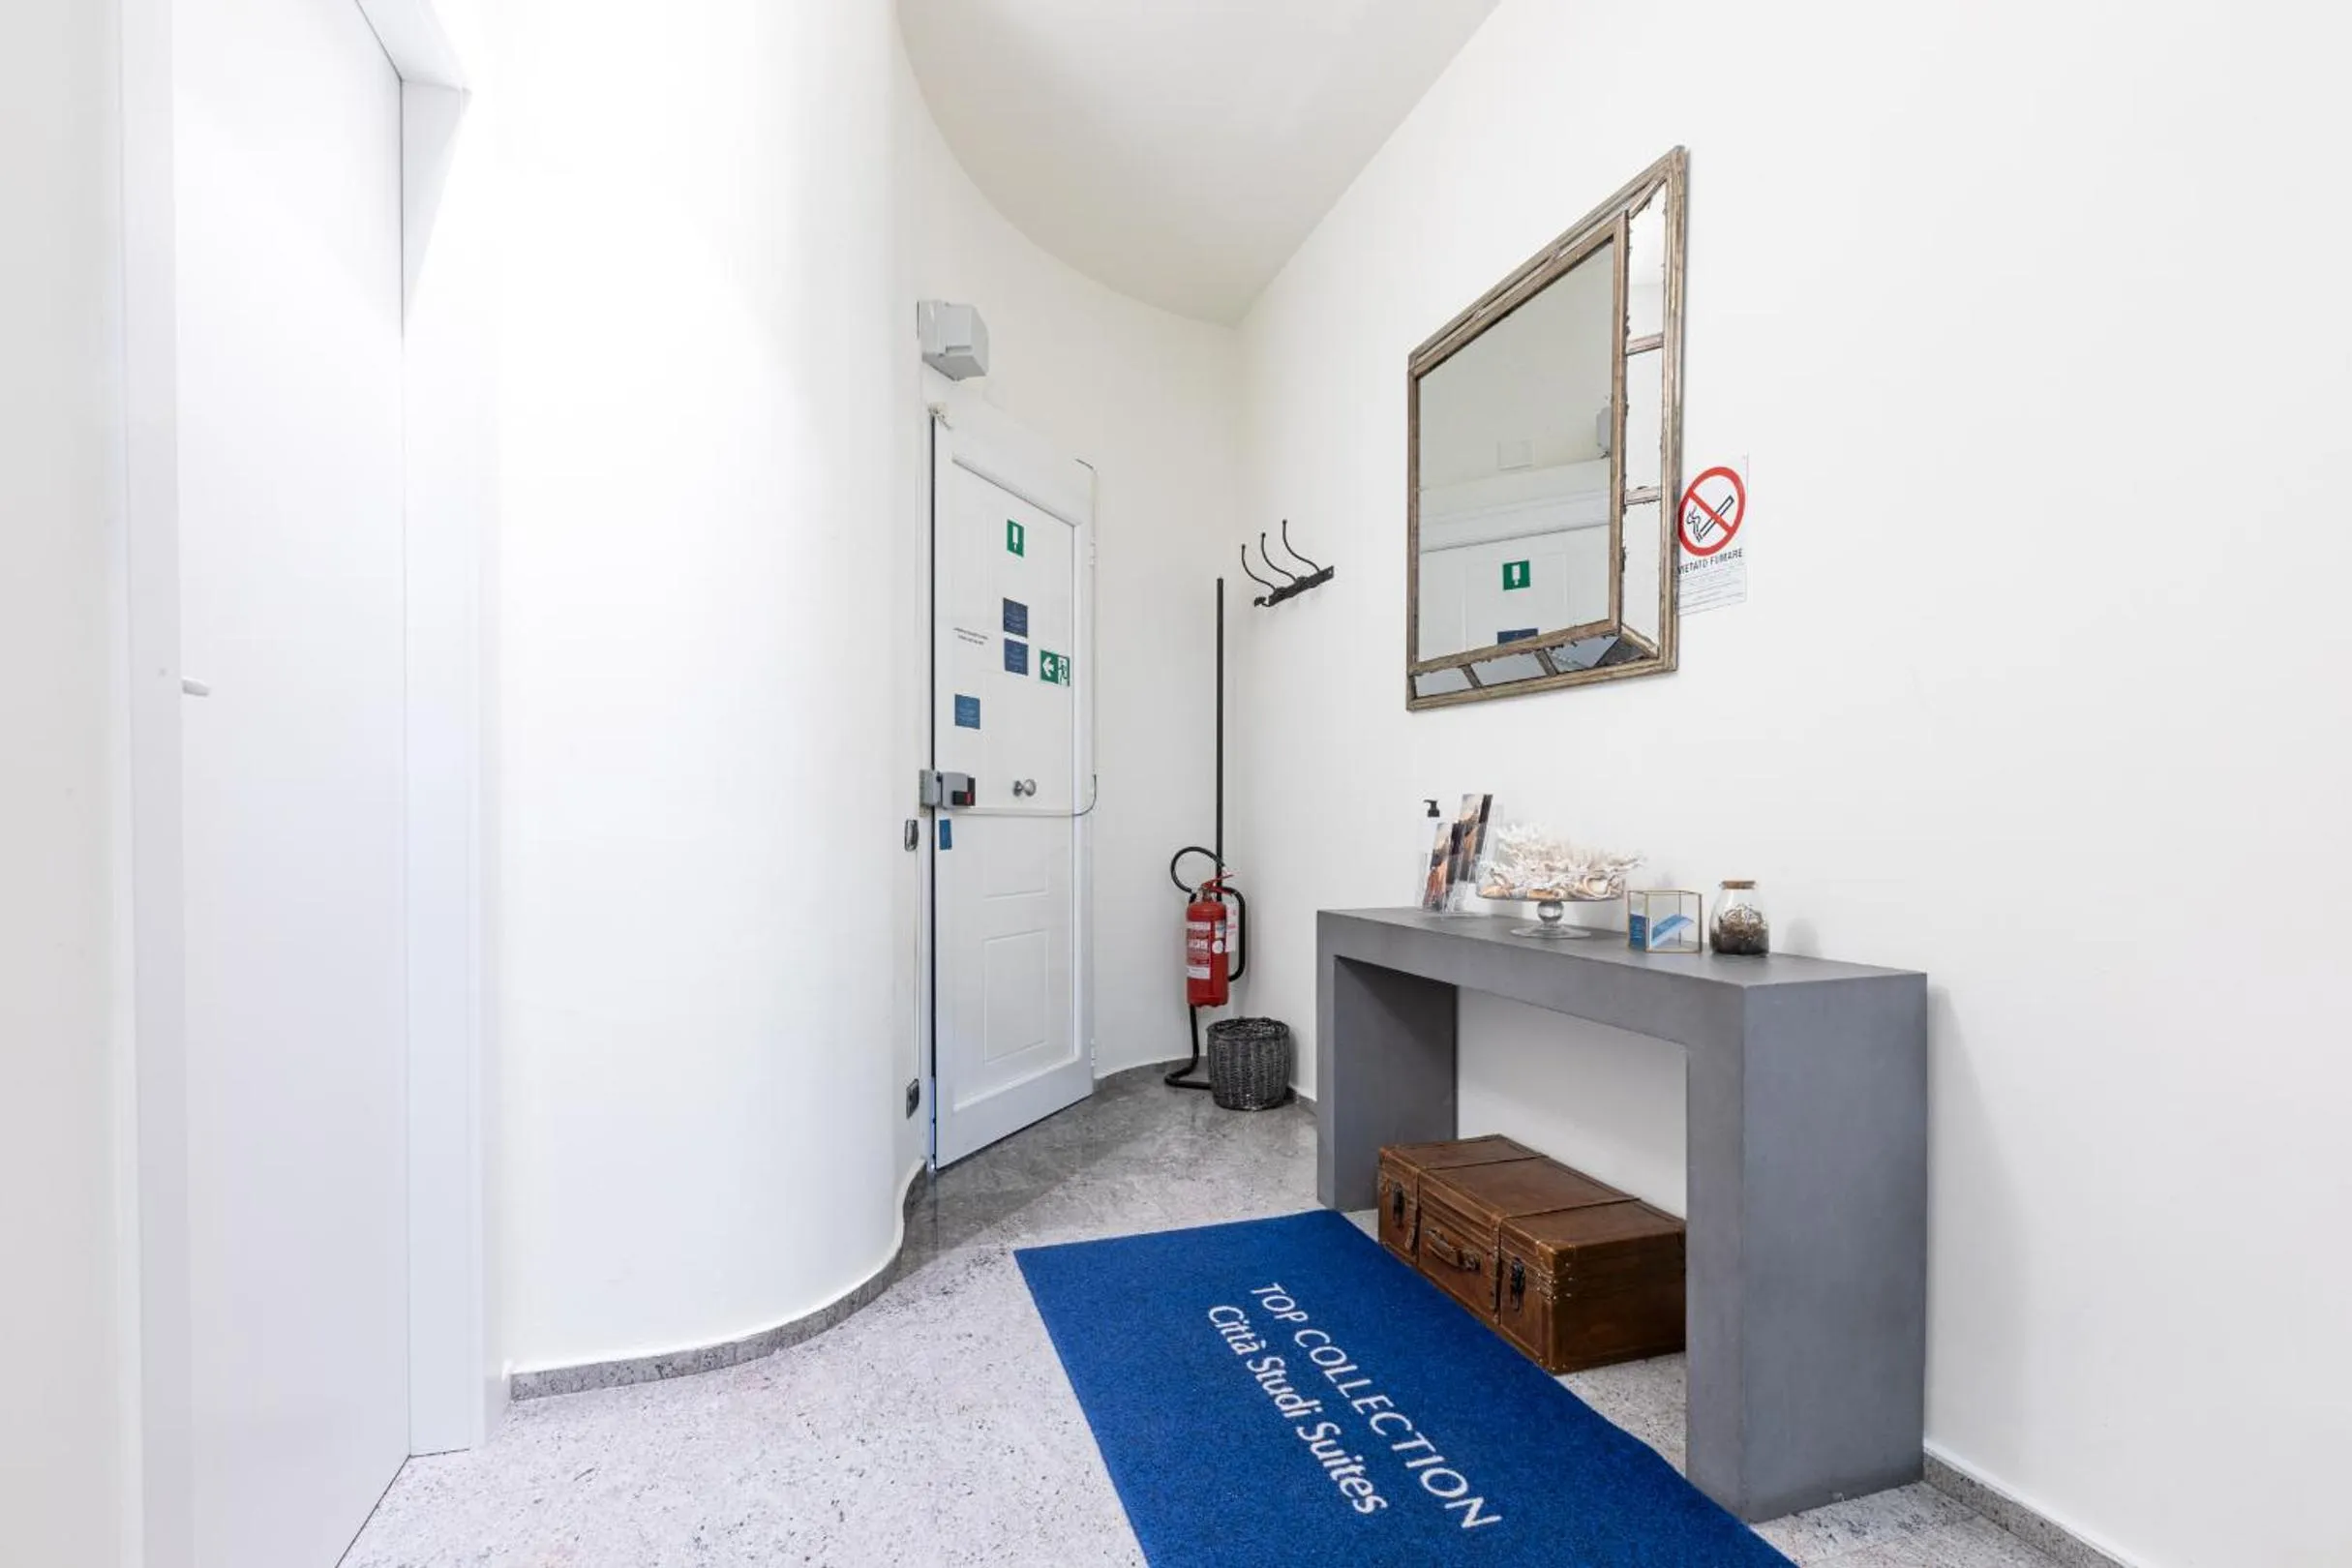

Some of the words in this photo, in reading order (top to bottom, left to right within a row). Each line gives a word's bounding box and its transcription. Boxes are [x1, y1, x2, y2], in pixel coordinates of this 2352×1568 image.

[1710, 549, 1742, 564] FUMARE
[1208, 1305, 1267, 1356] Città
[1246, 1356, 1323, 1418] Studi
[1296, 1422, 1388, 1514] Suites
[1251, 1282, 1309, 1322] TOP
[1294, 1329, 1502, 1528] COLLECTION
